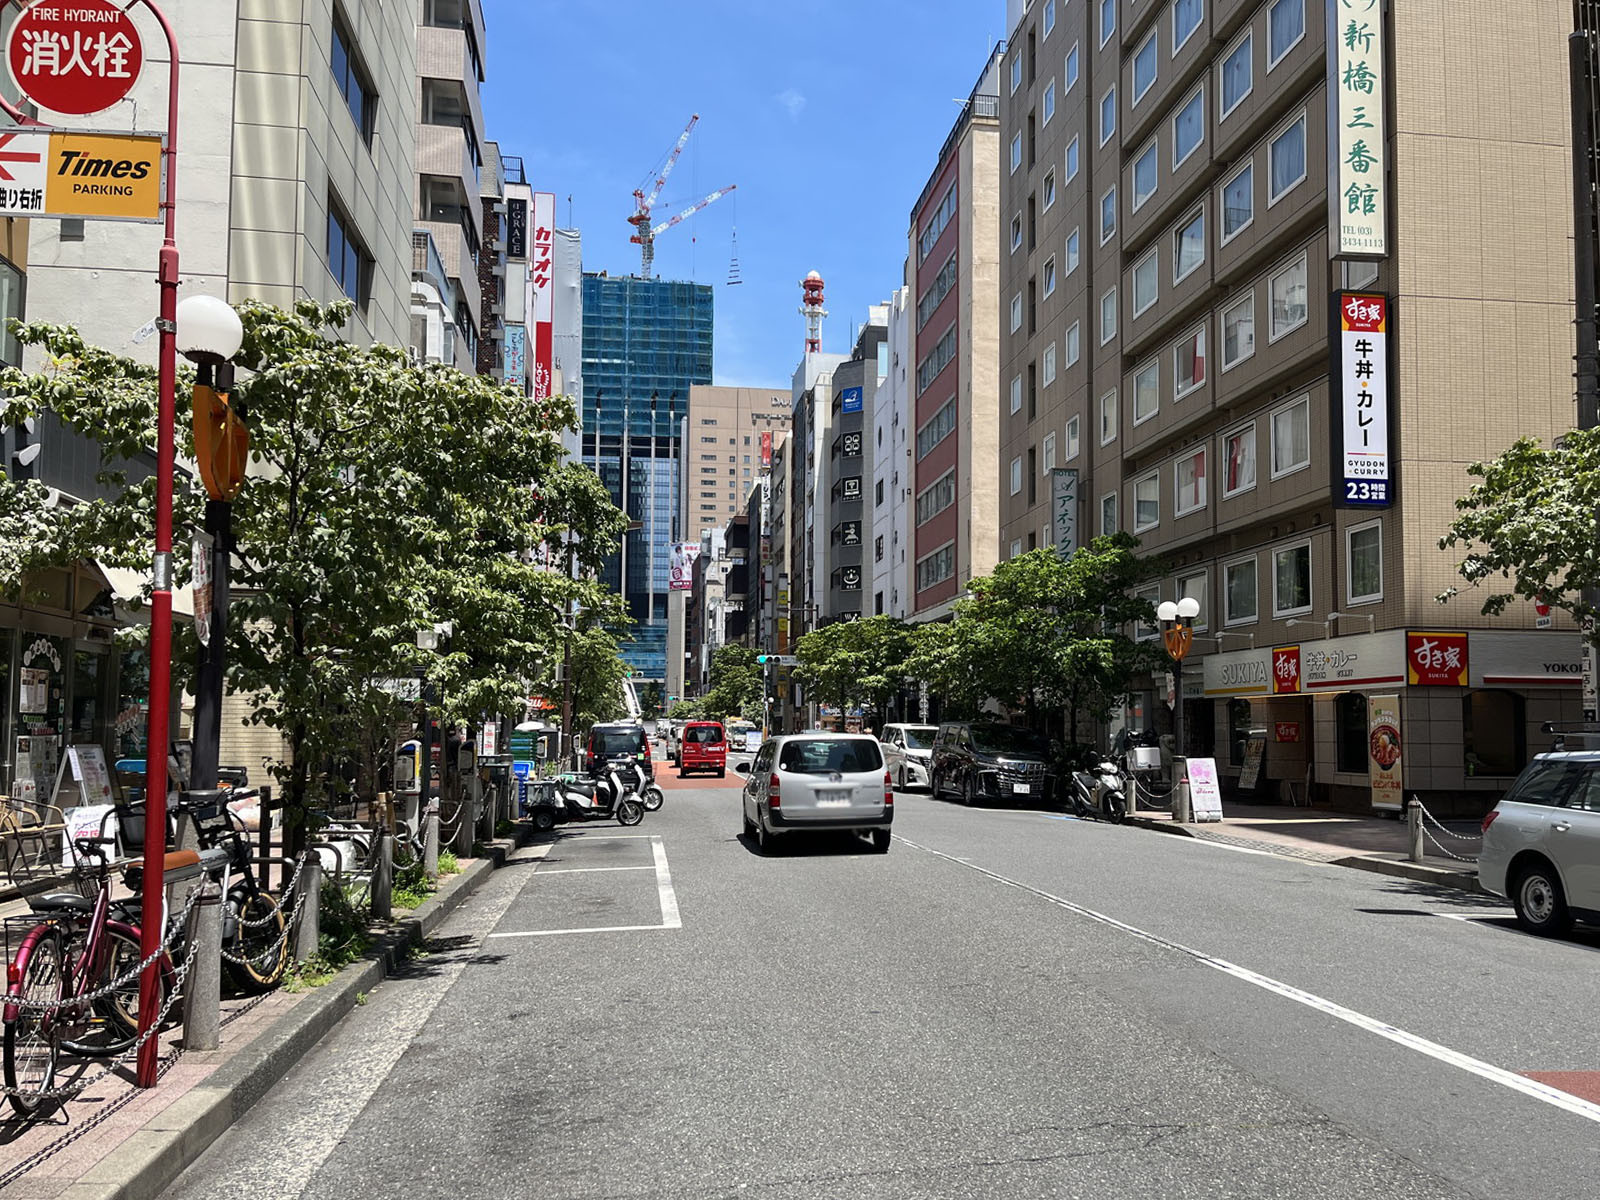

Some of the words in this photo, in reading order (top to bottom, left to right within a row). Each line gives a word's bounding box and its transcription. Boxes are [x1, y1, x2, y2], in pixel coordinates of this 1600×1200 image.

[32, 7, 60, 21] FIRE
[64, 9, 121, 23] HYDRANT
[21, 29, 133, 78] 消火栓
[1342, 0, 1379, 216] 新橋三番館
[57, 150, 151, 179] Times
[73, 184, 133, 196] PARKING
[1343, 225, 1356, 235] TEL
[534, 226, 552, 289] カラオケ
[1345, 297, 1381, 323] すき家
[1347, 459, 1385, 468] GYUDON
[1353, 467, 1384, 476] CURRY
[1346, 481, 1370, 500] 23
[1275, 653, 1297, 680] すき家
[1413, 638, 1461, 672] すき家
[1221, 661, 1268, 685] SUKIYA
